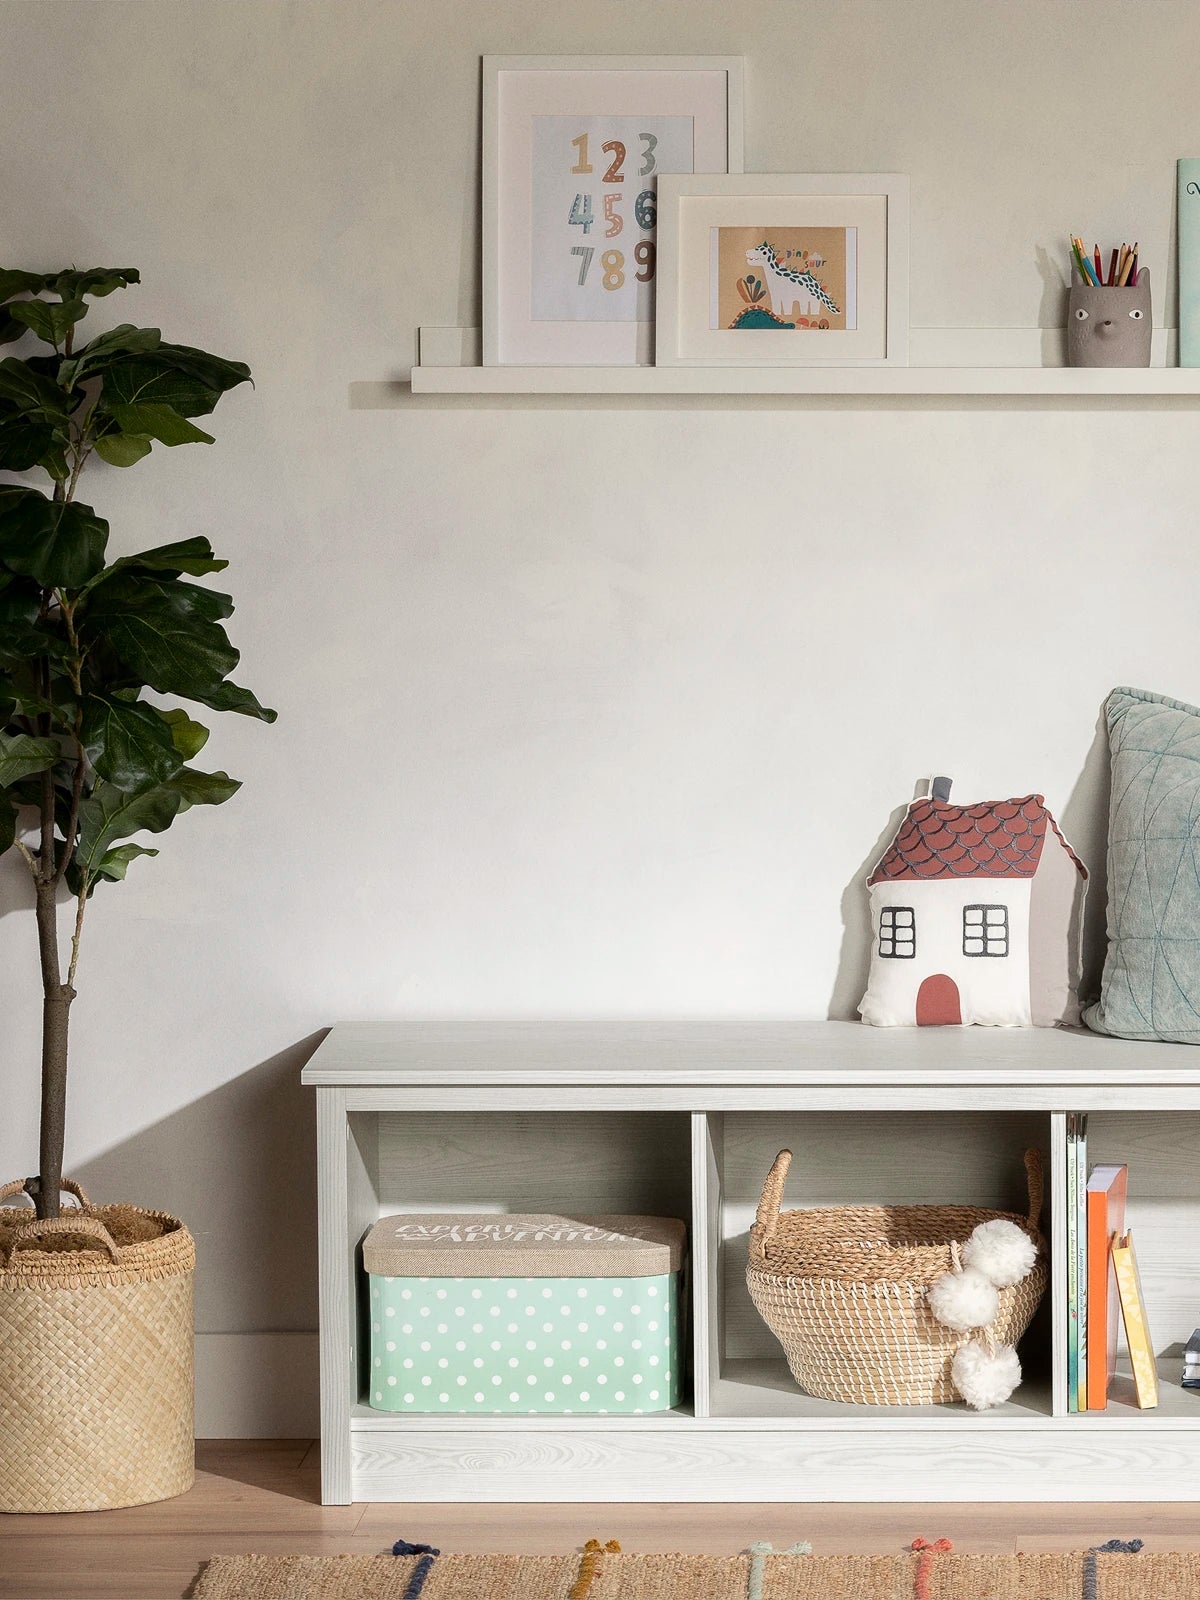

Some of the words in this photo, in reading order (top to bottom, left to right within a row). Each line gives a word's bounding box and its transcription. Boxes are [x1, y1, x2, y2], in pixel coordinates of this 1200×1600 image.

[569, 132, 594, 174] 1
[600, 140, 627, 183] 2
[637, 132, 658, 177] 3
[567, 193, 594, 235] 4
[603, 193, 624, 239] 5
[634, 189, 658, 231] 6
[570, 246, 596, 286] 7
[600, 248, 626, 292] 8
[633, 239, 658, 283] 9
[434, 1230, 652, 1242] ADVENTURE
